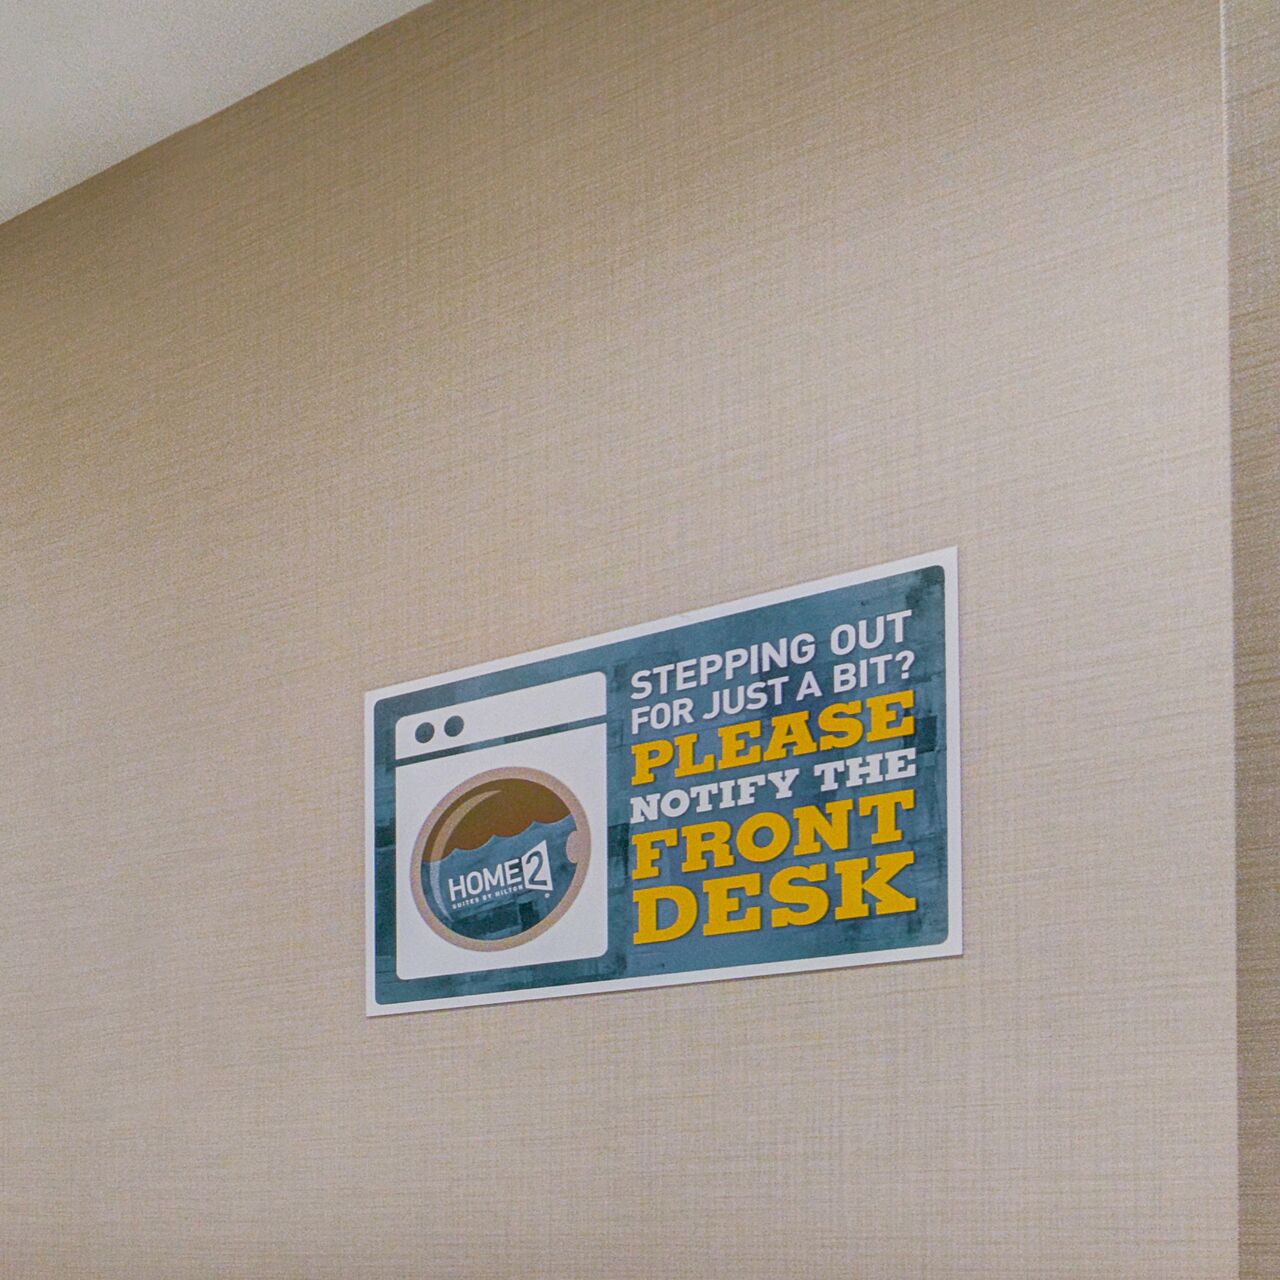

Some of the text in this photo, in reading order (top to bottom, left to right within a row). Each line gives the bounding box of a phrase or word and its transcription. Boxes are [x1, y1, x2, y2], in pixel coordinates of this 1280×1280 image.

[631, 610, 912, 701] STEPPING OUT
[631, 650, 915, 734] FOR JUST A BIT?
[631, 690, 915, 786] PLEASE
[631, 748, 917, 823] NOTIFY THE
[631, 789, 915, 880] FRONT
[452, 884, 524, 909] SUITES BY HILTON
[632, 851, 916, 945] DESK
